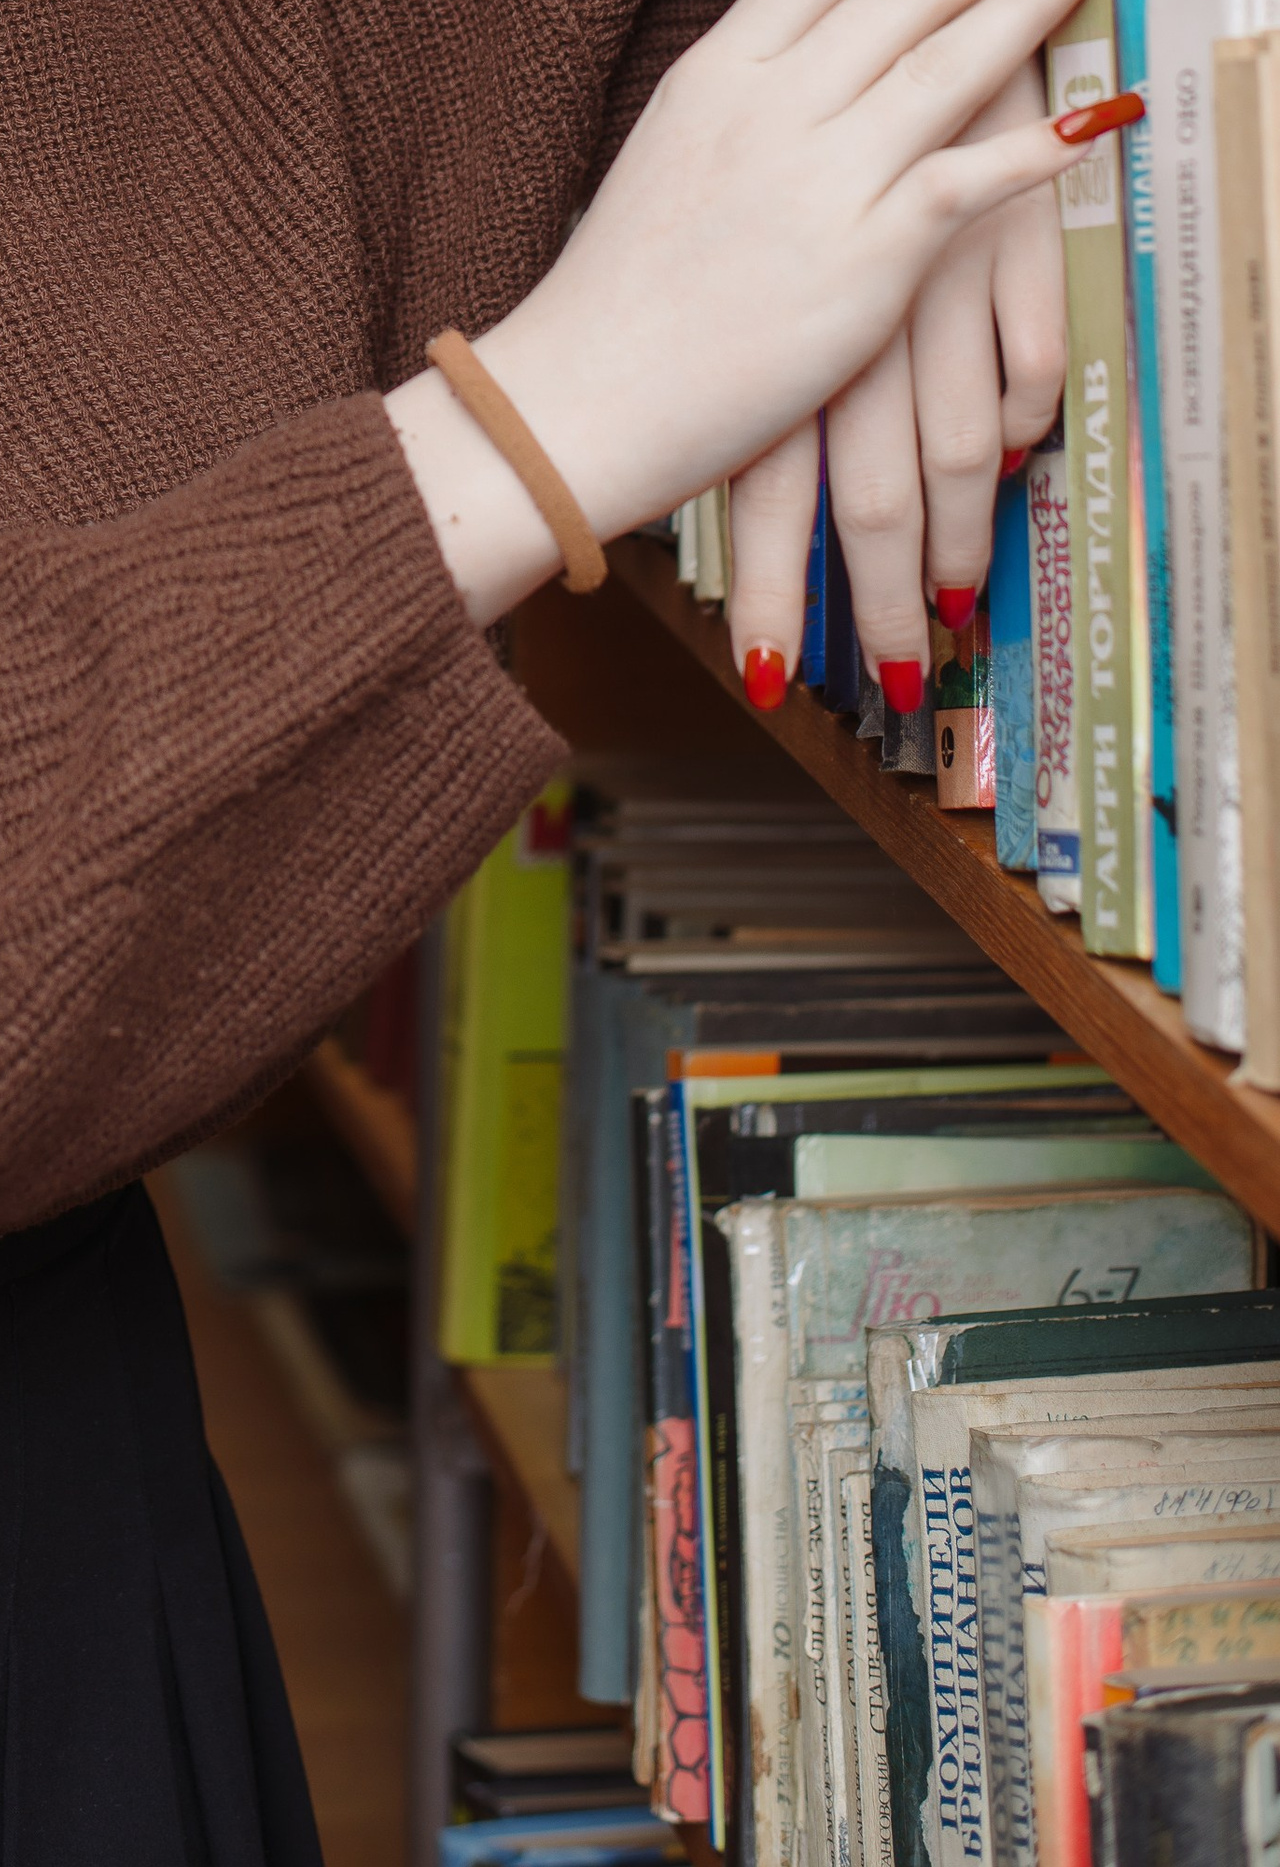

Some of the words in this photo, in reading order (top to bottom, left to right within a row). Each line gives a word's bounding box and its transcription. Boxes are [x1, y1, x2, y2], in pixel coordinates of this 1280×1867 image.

[1128, 78, 1157, 255] ПЛАНЕА
[1083, 358, 1117, 698] ТОРТЛДАВ
[1093, 724, 1119, 928] ГАРРИ
[921, 1463, 959, 1831] ПОХИТИТЕЛИ
[948, 1466, 982, 1862] БРИЛЛИАНТОВ
